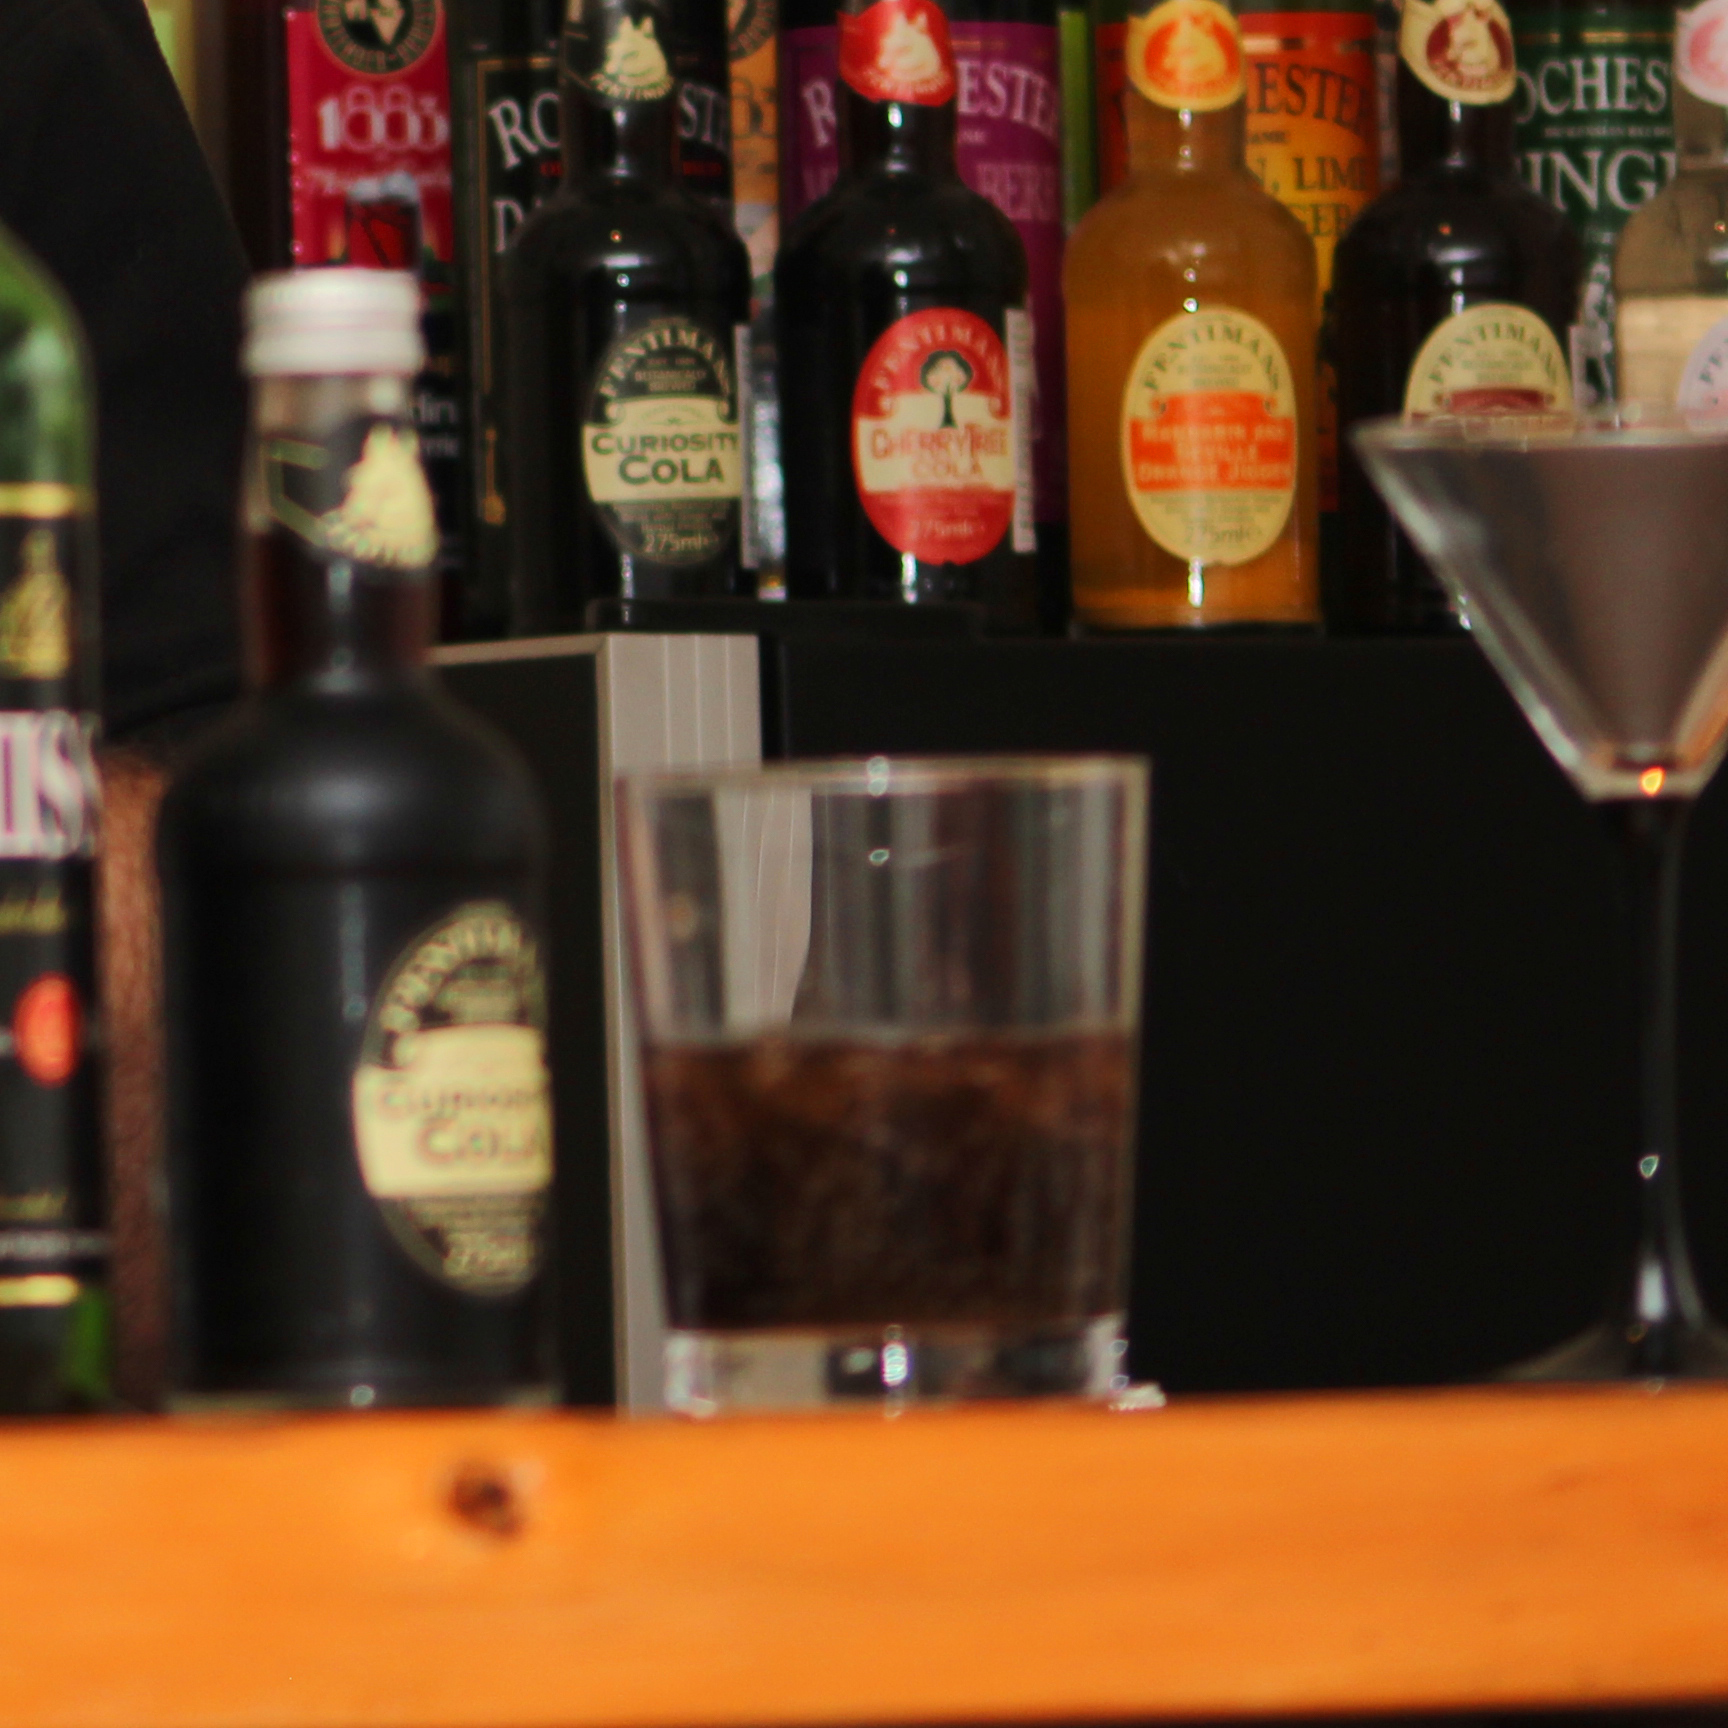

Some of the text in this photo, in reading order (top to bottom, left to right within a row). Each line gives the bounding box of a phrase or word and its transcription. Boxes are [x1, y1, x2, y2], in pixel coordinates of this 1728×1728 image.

[317, 84, 451, 152] 1883
[591, 431, 738, 456] CURIOSITY
[619, 456, 725, 486] COLA
[911, 459, 985, 478] COLA
